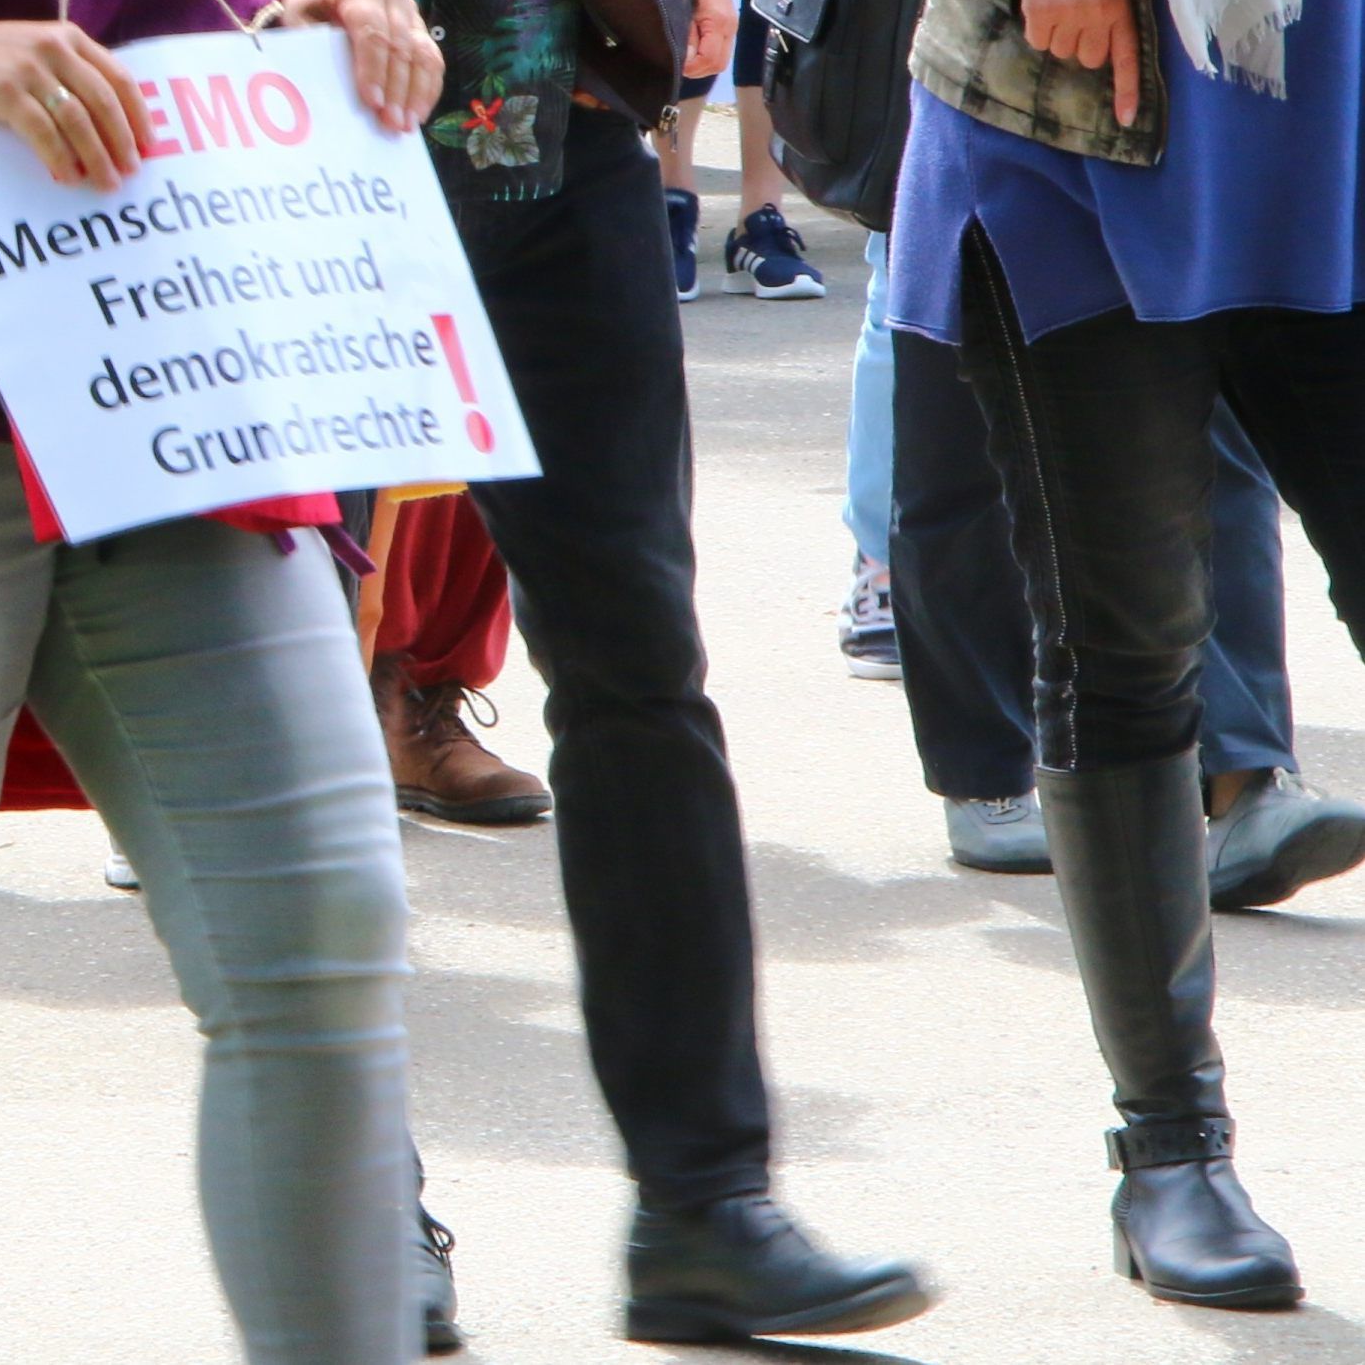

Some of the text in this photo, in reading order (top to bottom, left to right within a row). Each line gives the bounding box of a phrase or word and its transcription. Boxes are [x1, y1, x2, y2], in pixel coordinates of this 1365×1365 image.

[136, 71, 312, 160] EMO
[90, 240, 384, 328] Freiheit und
[89, 318, 436, 410] demokratische
[151, 404, 443, 476] Grundrechte
